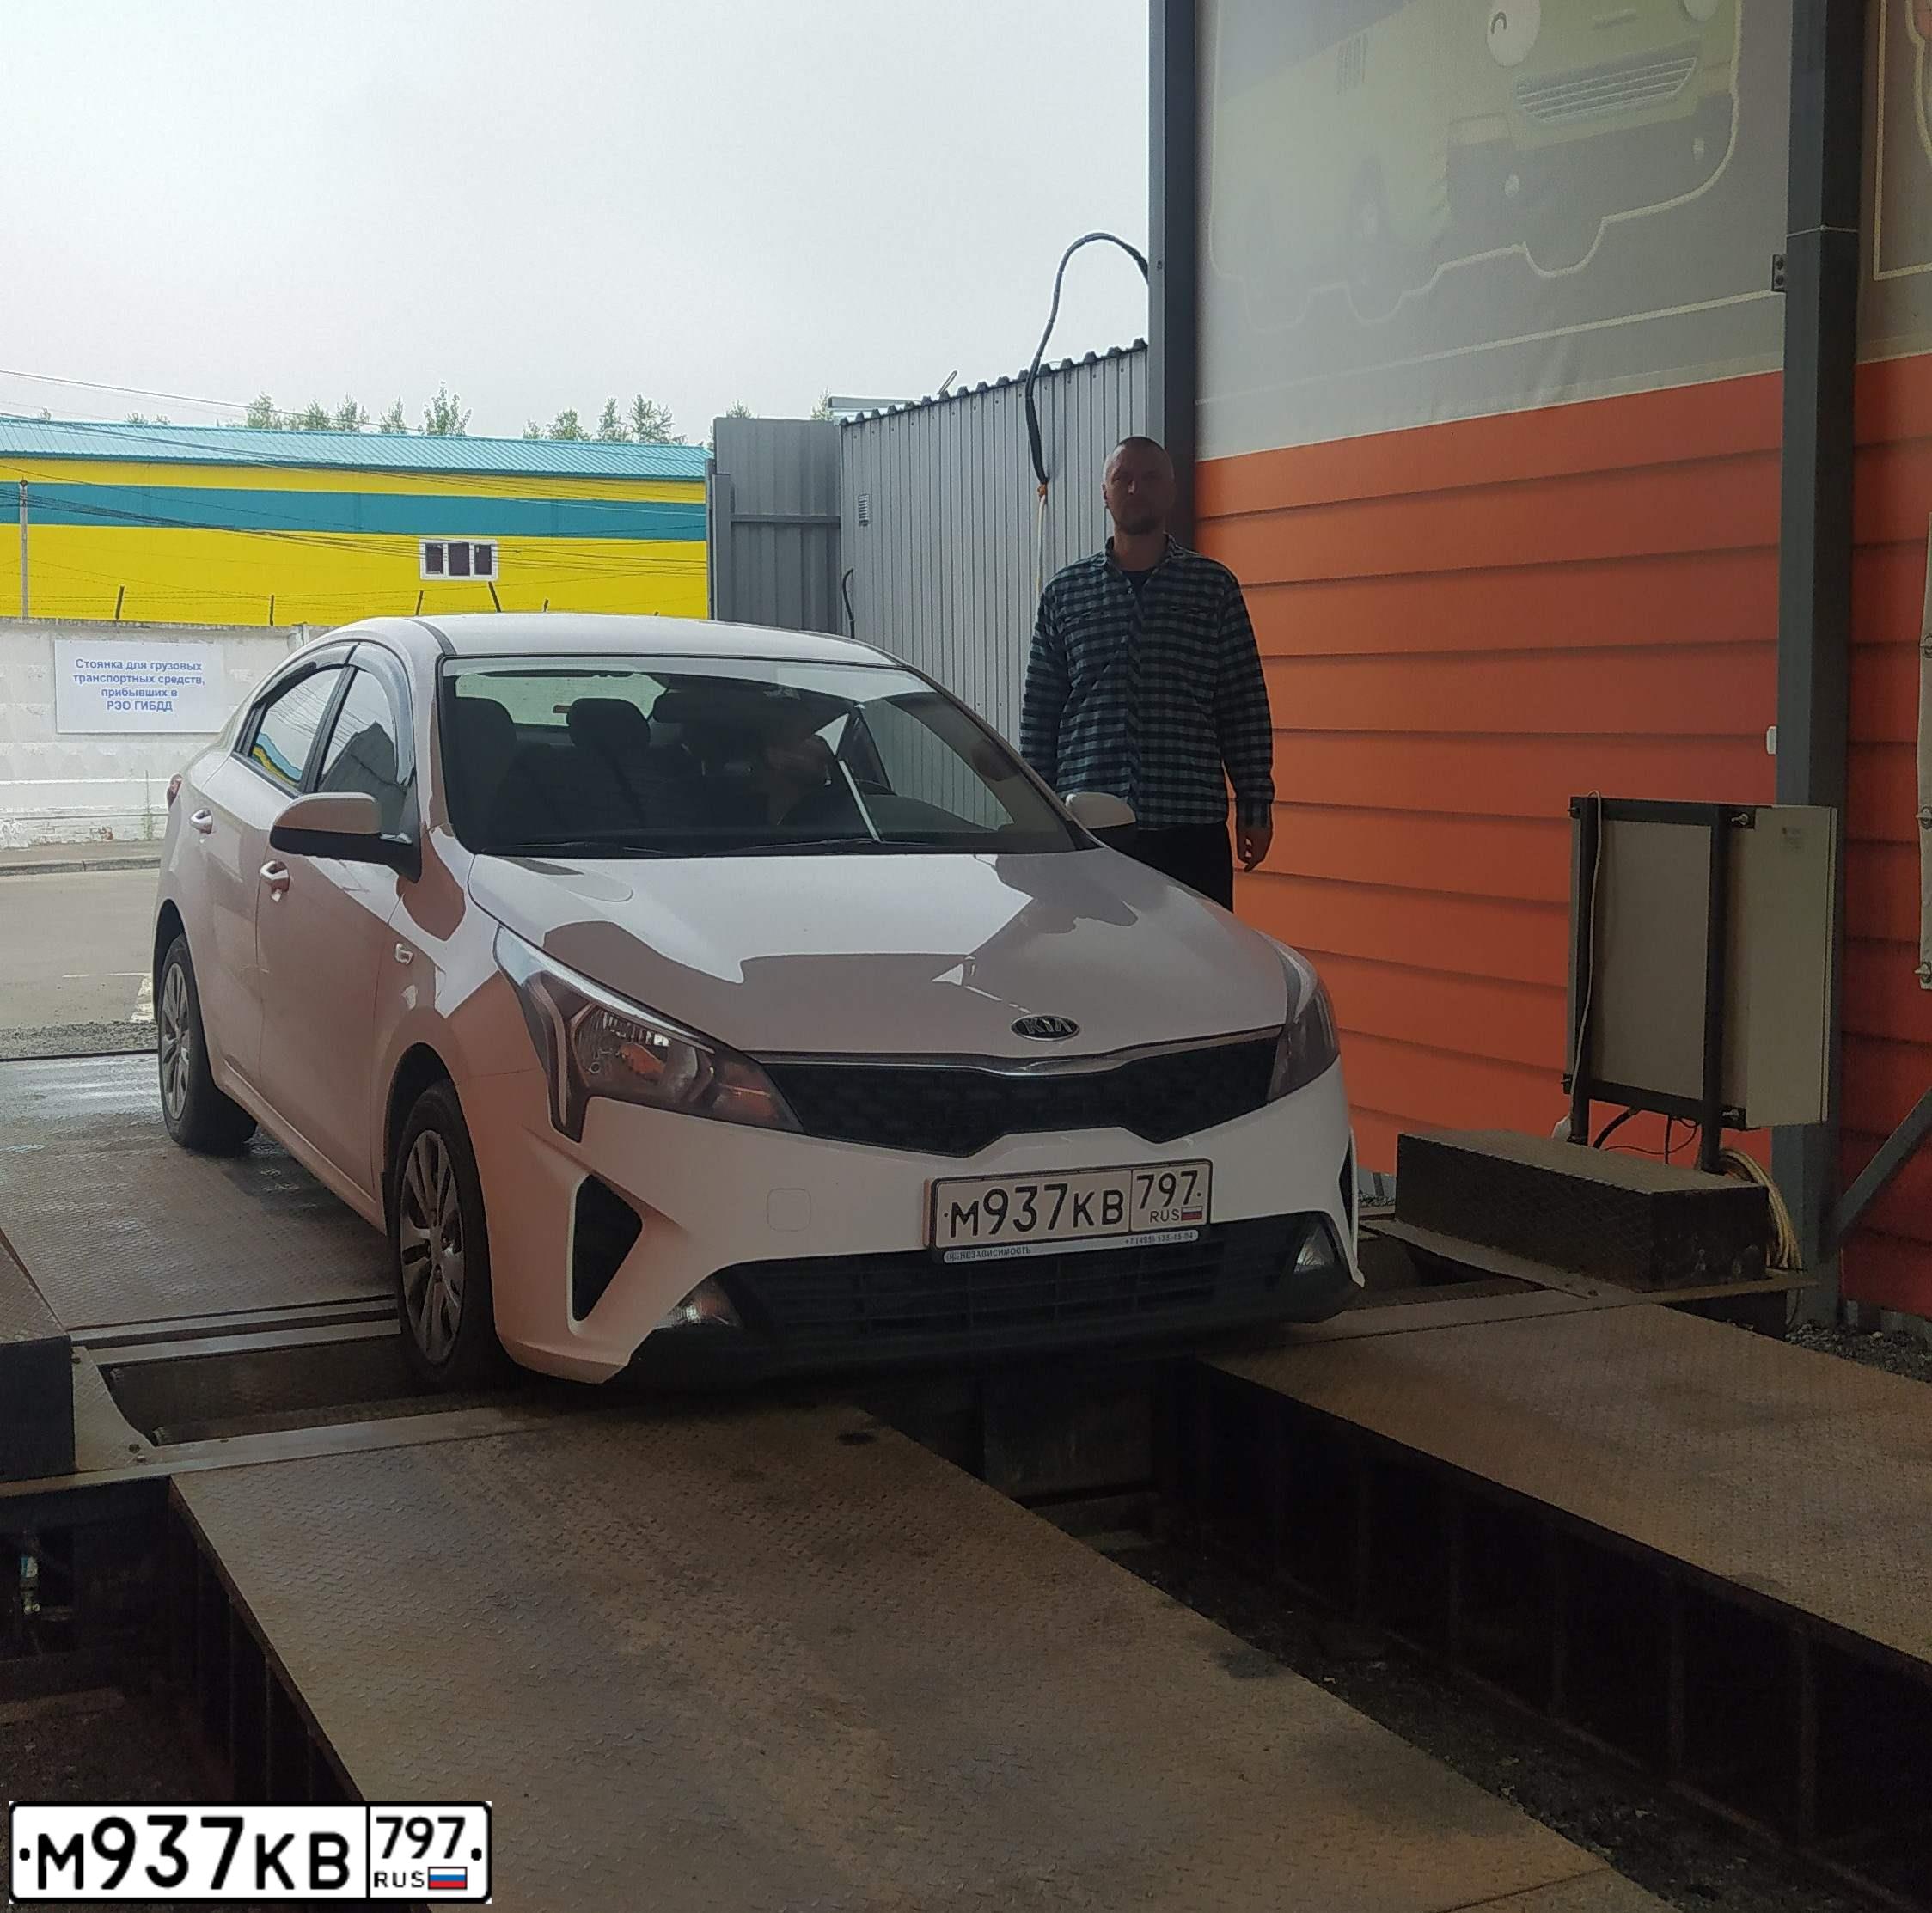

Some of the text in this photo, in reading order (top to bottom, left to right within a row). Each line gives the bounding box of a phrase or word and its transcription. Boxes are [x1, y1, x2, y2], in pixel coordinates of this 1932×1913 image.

[76, 658, 202, 672] Стоянка для грузовых
[73, 674, 205, 686] транспортных средств,
[101, 688, 168, 698] прибывших
[107, 700, 173, 712] РЭО ГИБДД
[1023, 1018, 1073, 1034] KIA
[1135, 1170, 1199, 1209] 797
[1149, 1210, 1179, 1223] RUS
